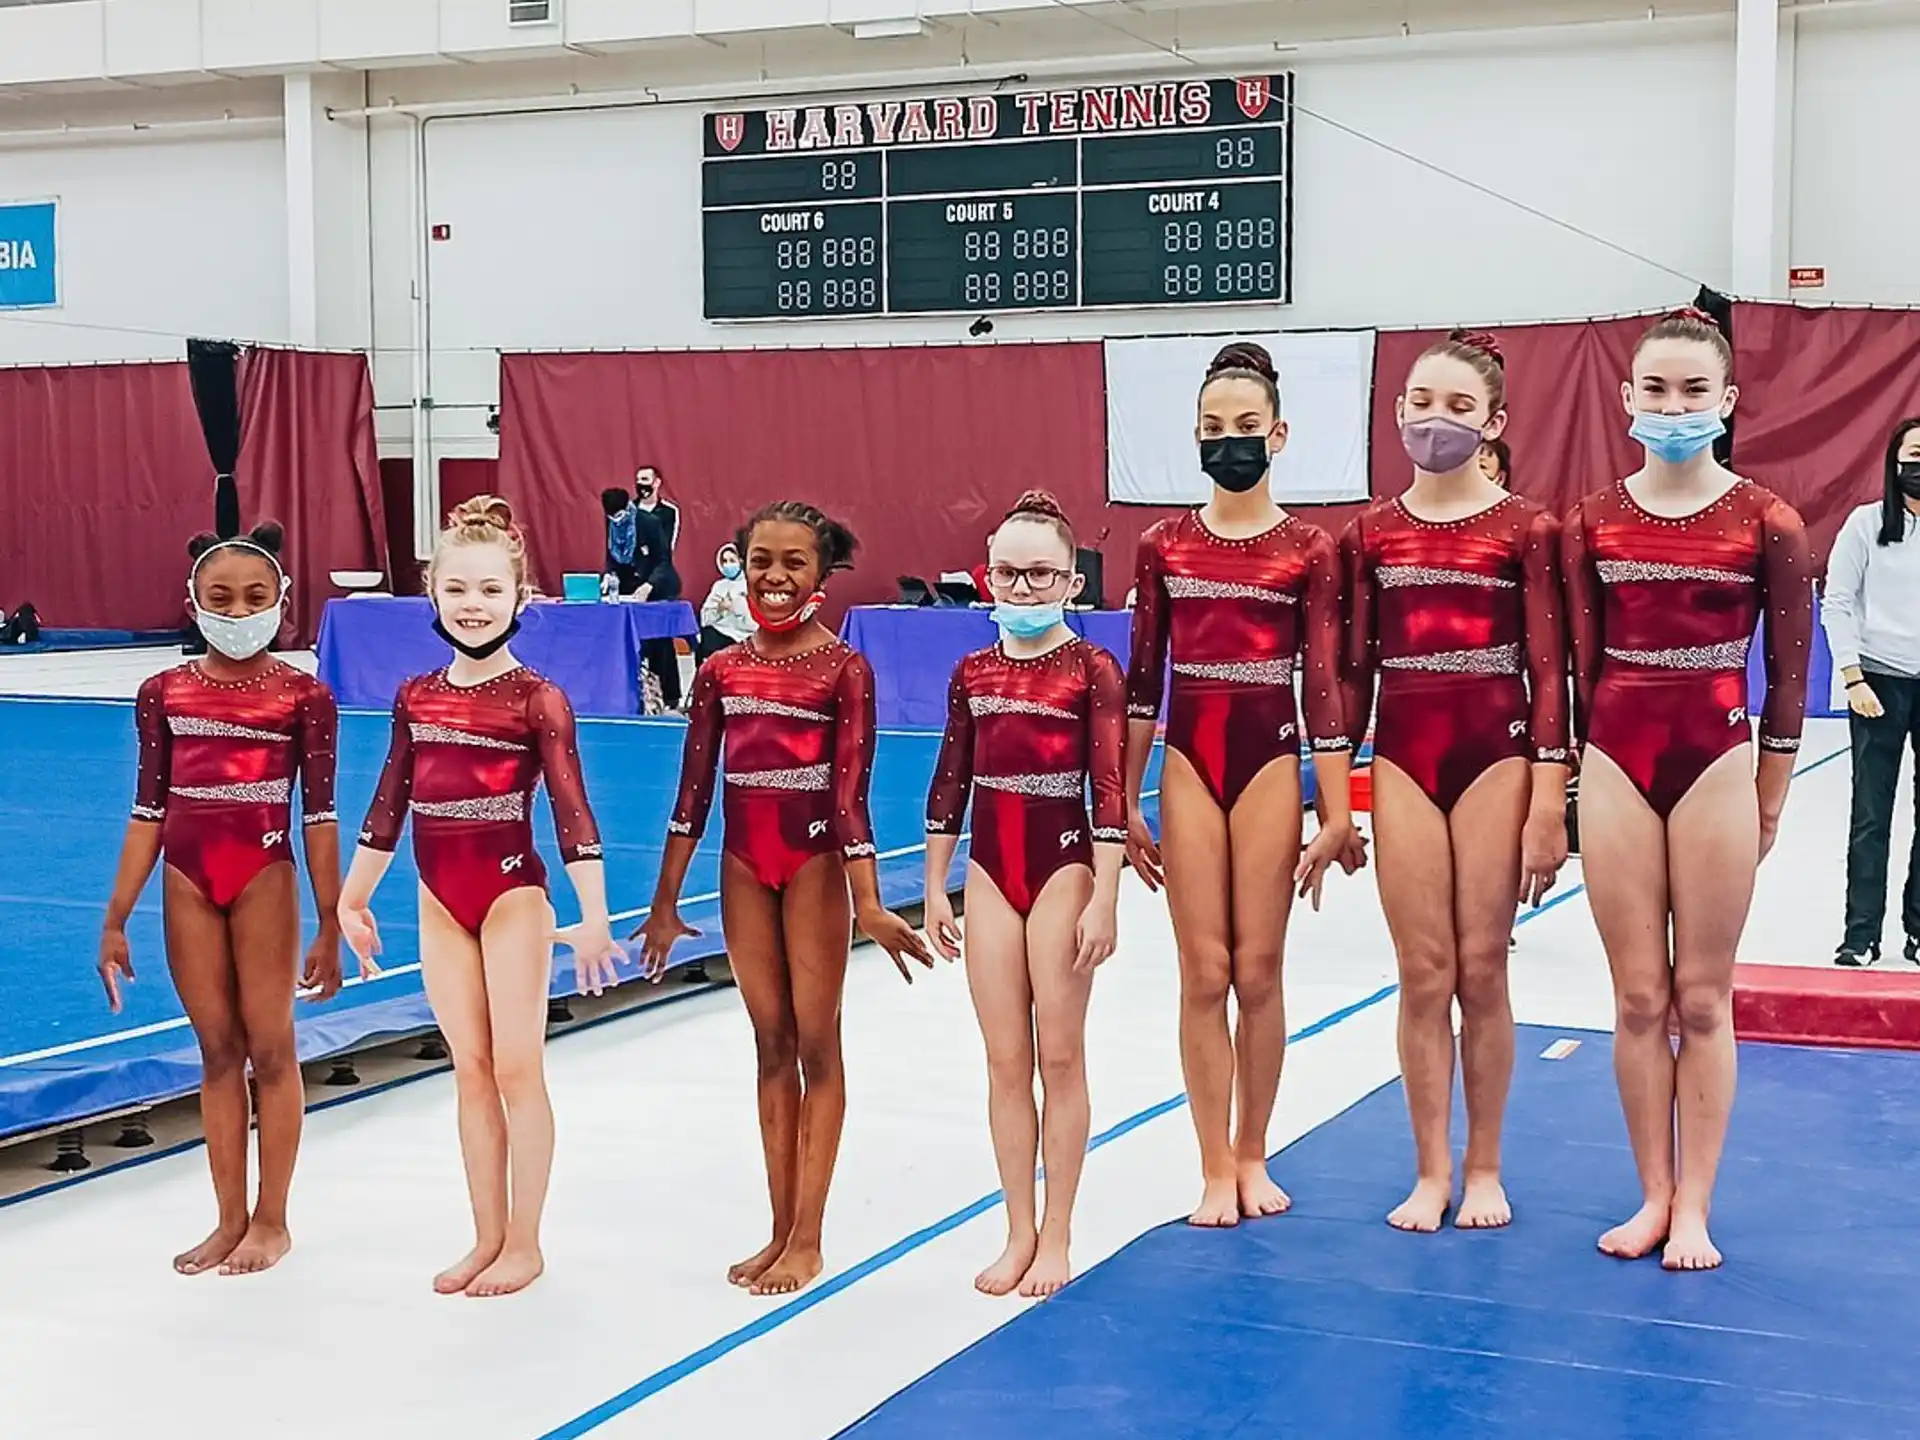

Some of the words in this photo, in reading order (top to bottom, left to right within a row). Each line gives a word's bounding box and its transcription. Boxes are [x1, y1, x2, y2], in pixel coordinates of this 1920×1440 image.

[1245, 81, 1262, 106] H
[765, 96, 997, 150] HARVARD
[1015, 81, 1211, 135] TENNIS
[722, 117, 737, 141] H
[946, 203, 997, 223] COURT
[1002, 202, 1013, 220] 5
[1148, 192, 1205, 213] COURT
[1208, 191, 1220, 210] 4
[760, 213, 811, 233] COURT
[813, 211, 825, 230] 6
